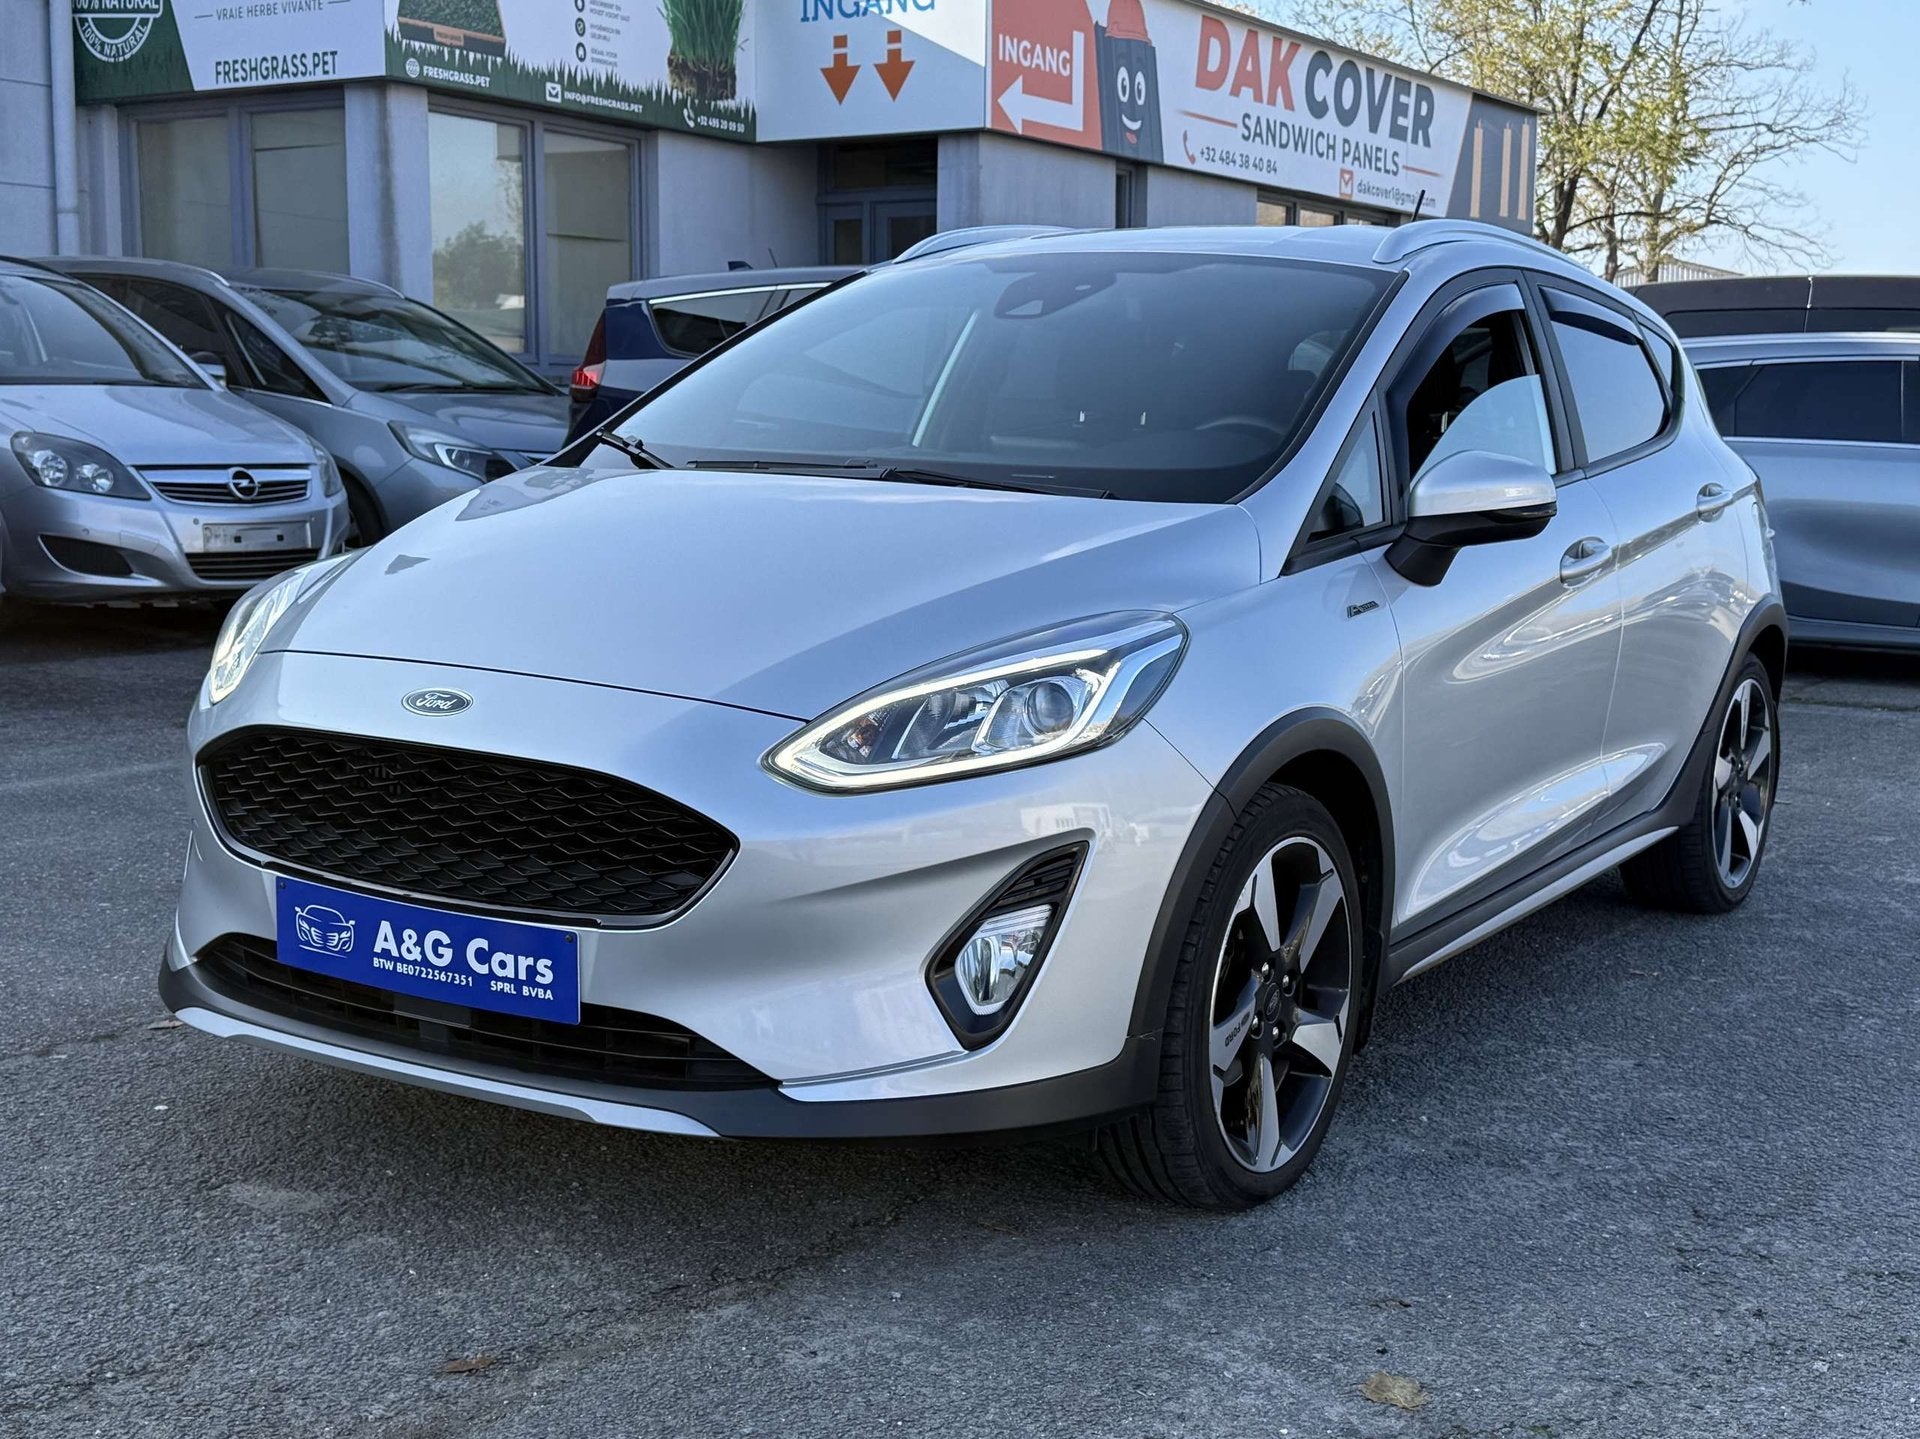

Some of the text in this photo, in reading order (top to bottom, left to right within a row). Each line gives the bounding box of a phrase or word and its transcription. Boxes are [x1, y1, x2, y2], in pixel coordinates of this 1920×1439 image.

[215, 0, 323, 21] VRAIE HERBE VIVANTE
[80, 22, 147, 57] 100% NATURAL
[998, 33, 1072, 77] INGANG
[215, 50, 338, 85] FRESHGRASS.PET
[423, 65, 491, 88] FRESHGRASS.PET
[564, 91, 643, 114] INFO@FRESHGRASS.PET
[1200, 146, 1277, 174] +32 484 38 40 84
[1241, 112, 1400, 177] SANDWICH PANELS
[415, 692, 458, 710] Ford
[373, 920, 555, 985] A&G Cars
[373, 957, 554, 1001] BTW BE0722567351 SPRL BVBA
[1225, 1022, 1241, 1047] FORD
